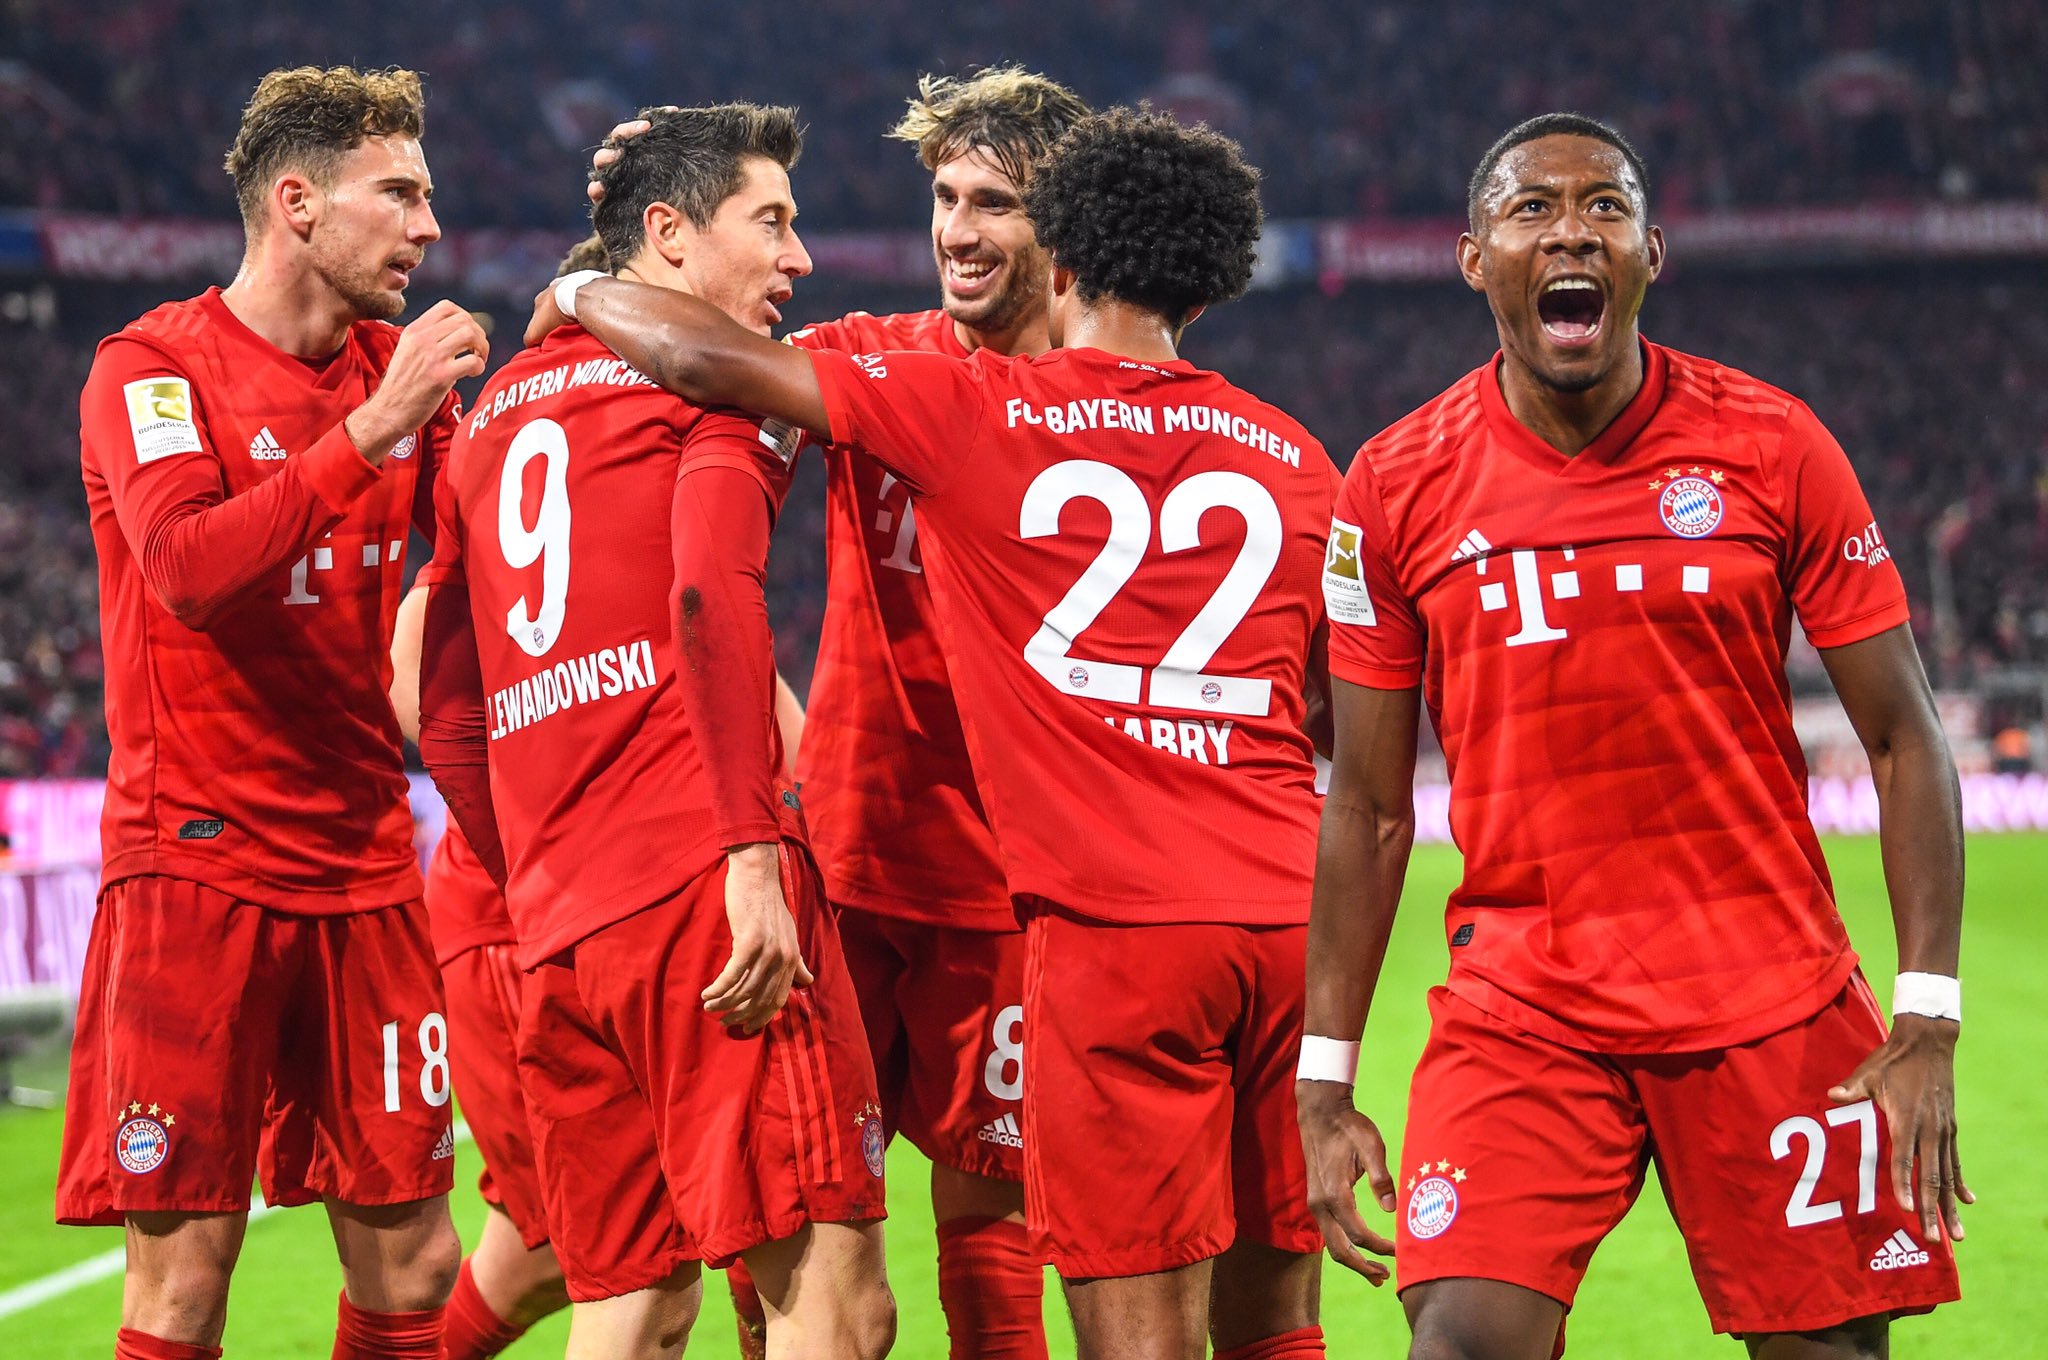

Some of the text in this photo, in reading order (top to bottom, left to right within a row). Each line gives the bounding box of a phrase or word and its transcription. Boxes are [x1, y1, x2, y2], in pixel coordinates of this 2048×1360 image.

[469, 402, 491, 440] FC
[493, 364, 569, 420] BAYERN
[250, 447, 288, 460] adidas
[1044, 397, 1155, 435] BAYERN
[1164, 404, 1301, 469] MÜNCHEN
[1663, 481, 1717, 507] FC BAYERN
[497, 417, 572, 658] 9
[1666, 510, 1719, 535] MÜNCHEN
[1843, 520, 1881, 562] QAT
[1018, 458, 1284, 717] 22
[487, 639, 657, 741] LEWANDOWSKI
[1104, 715, 1234, 765] ABRY
[382, 1011, 451, 1113] 18
[122, 1121, 165, 1144] FC BAYERN
[977, 1130, 1024, 1149] adidas
[1768, 1098, 1878, 1229] 27
[1421, 1181, 1454, 1202] BAYERN
[1870, 1250, 1930, 1271] adidas
